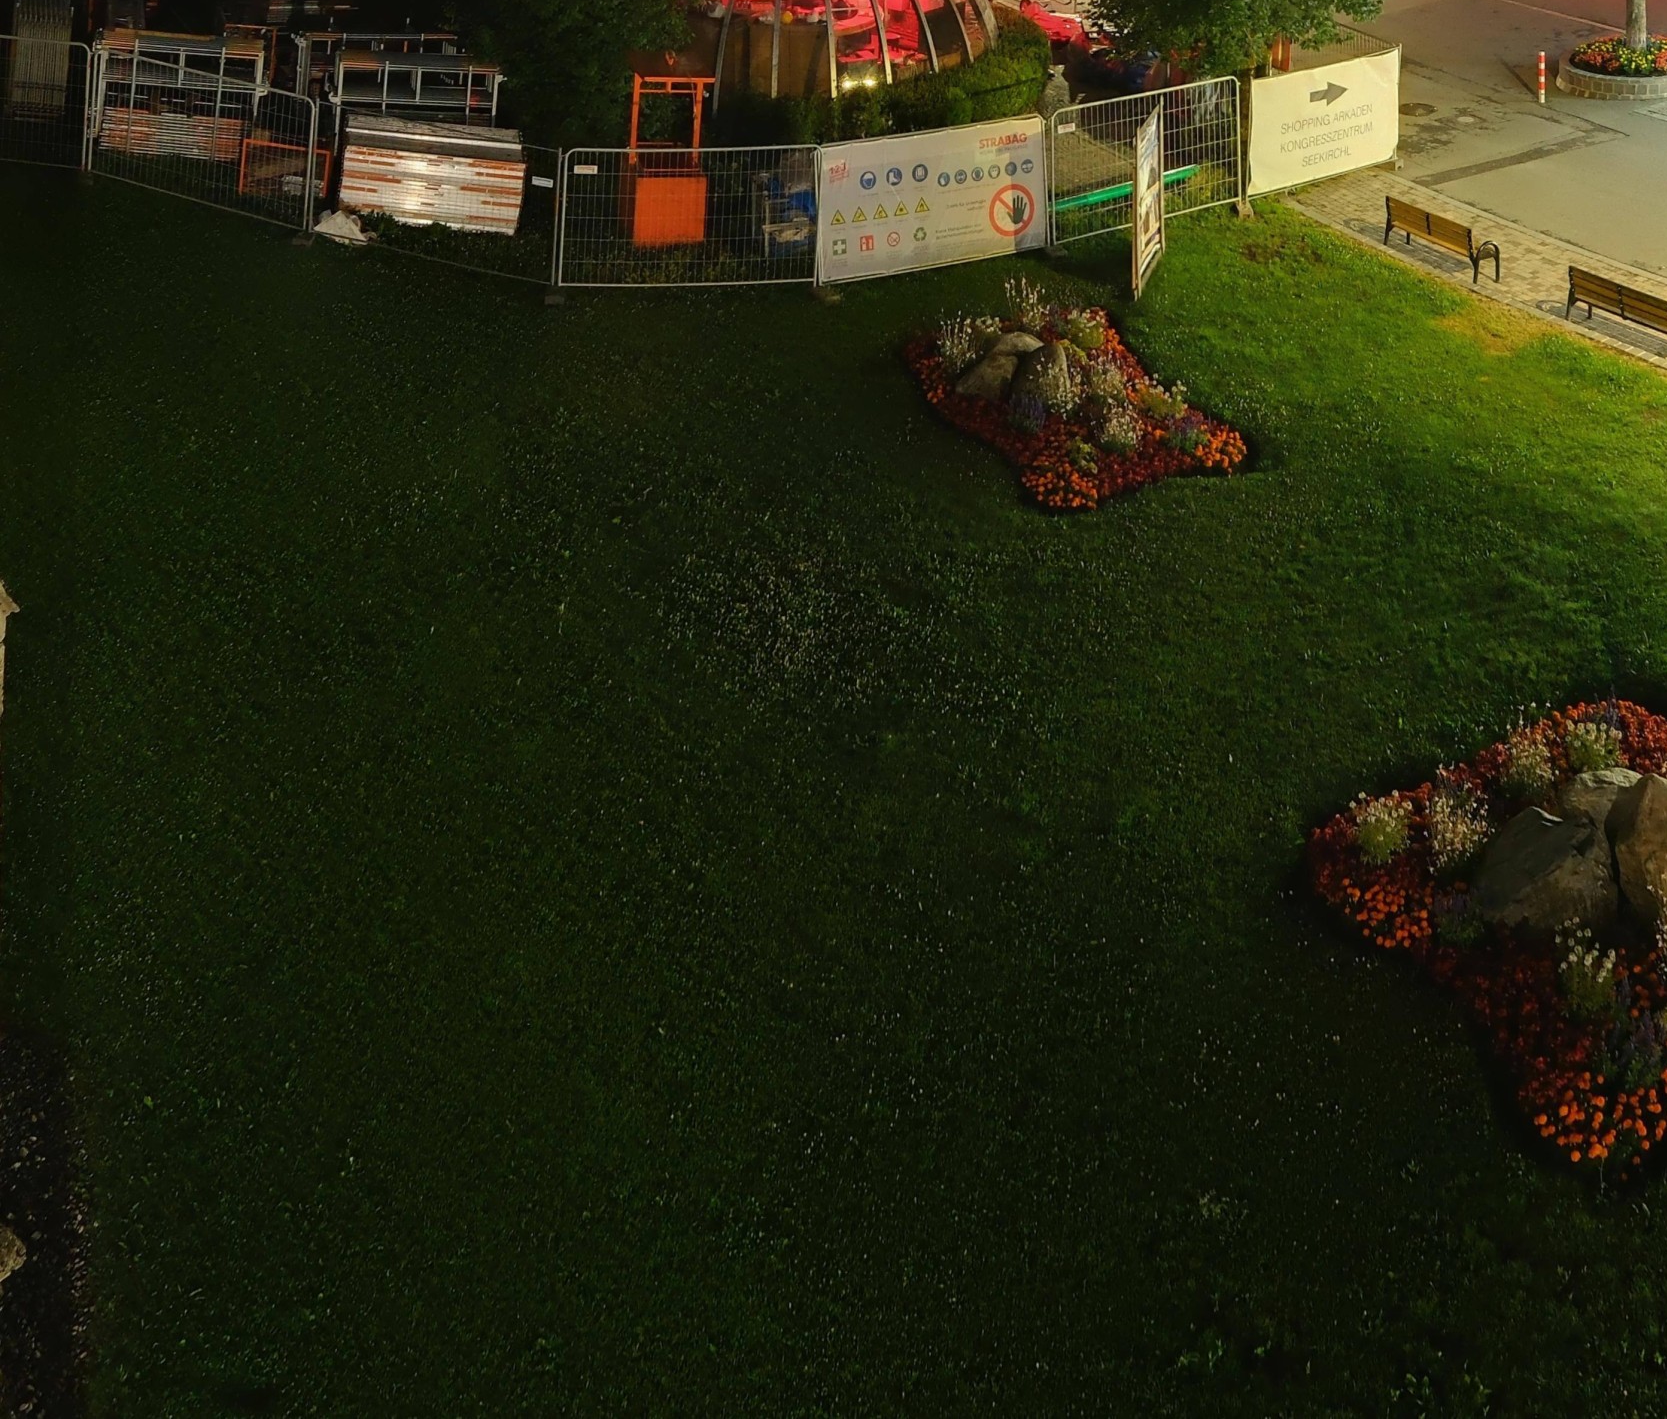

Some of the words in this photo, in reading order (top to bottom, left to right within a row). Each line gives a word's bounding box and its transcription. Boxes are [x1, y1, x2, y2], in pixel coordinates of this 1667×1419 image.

[1280, 113, 1331, 135] SHOPPING
[1332, 103, 1373, 123] ARKADEN
[979, 133, 1028, 149] STRABAG
[1280, 121, 1373, 154] KONGRESSZENTRUM
[1301, 145, 1352, 167] SEEKIRCHL
